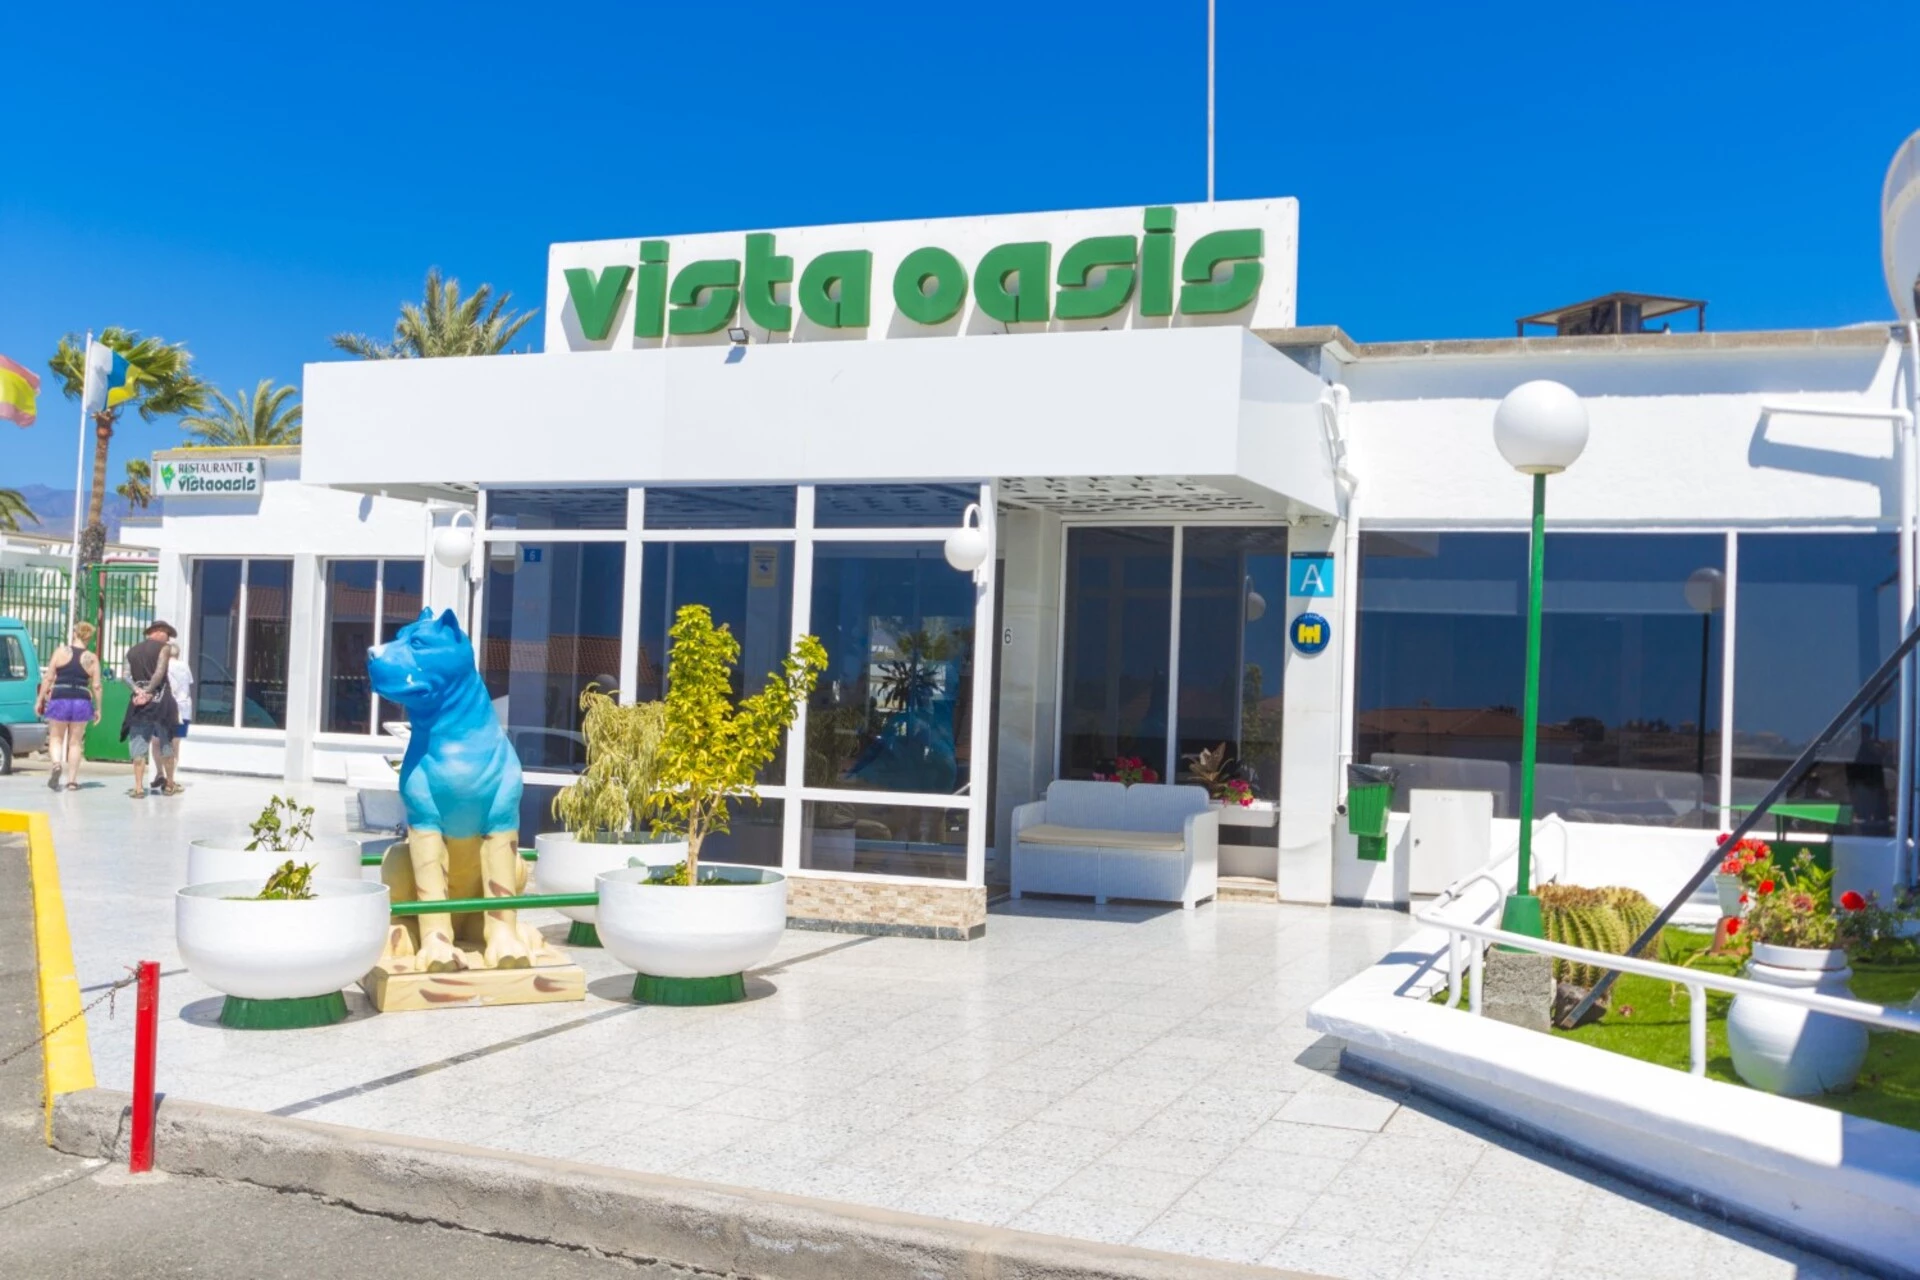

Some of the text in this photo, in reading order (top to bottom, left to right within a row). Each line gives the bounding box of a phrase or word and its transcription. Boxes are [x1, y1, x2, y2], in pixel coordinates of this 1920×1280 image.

[563, 205, 1264, 341] vista oasis
[178, 462, 243, 474] RESTAURANTE
[178, 476, 256, 491] vistaoasis
[1300, 563, 1325, 592] A
[1004, 628, 1012, 644] 6
